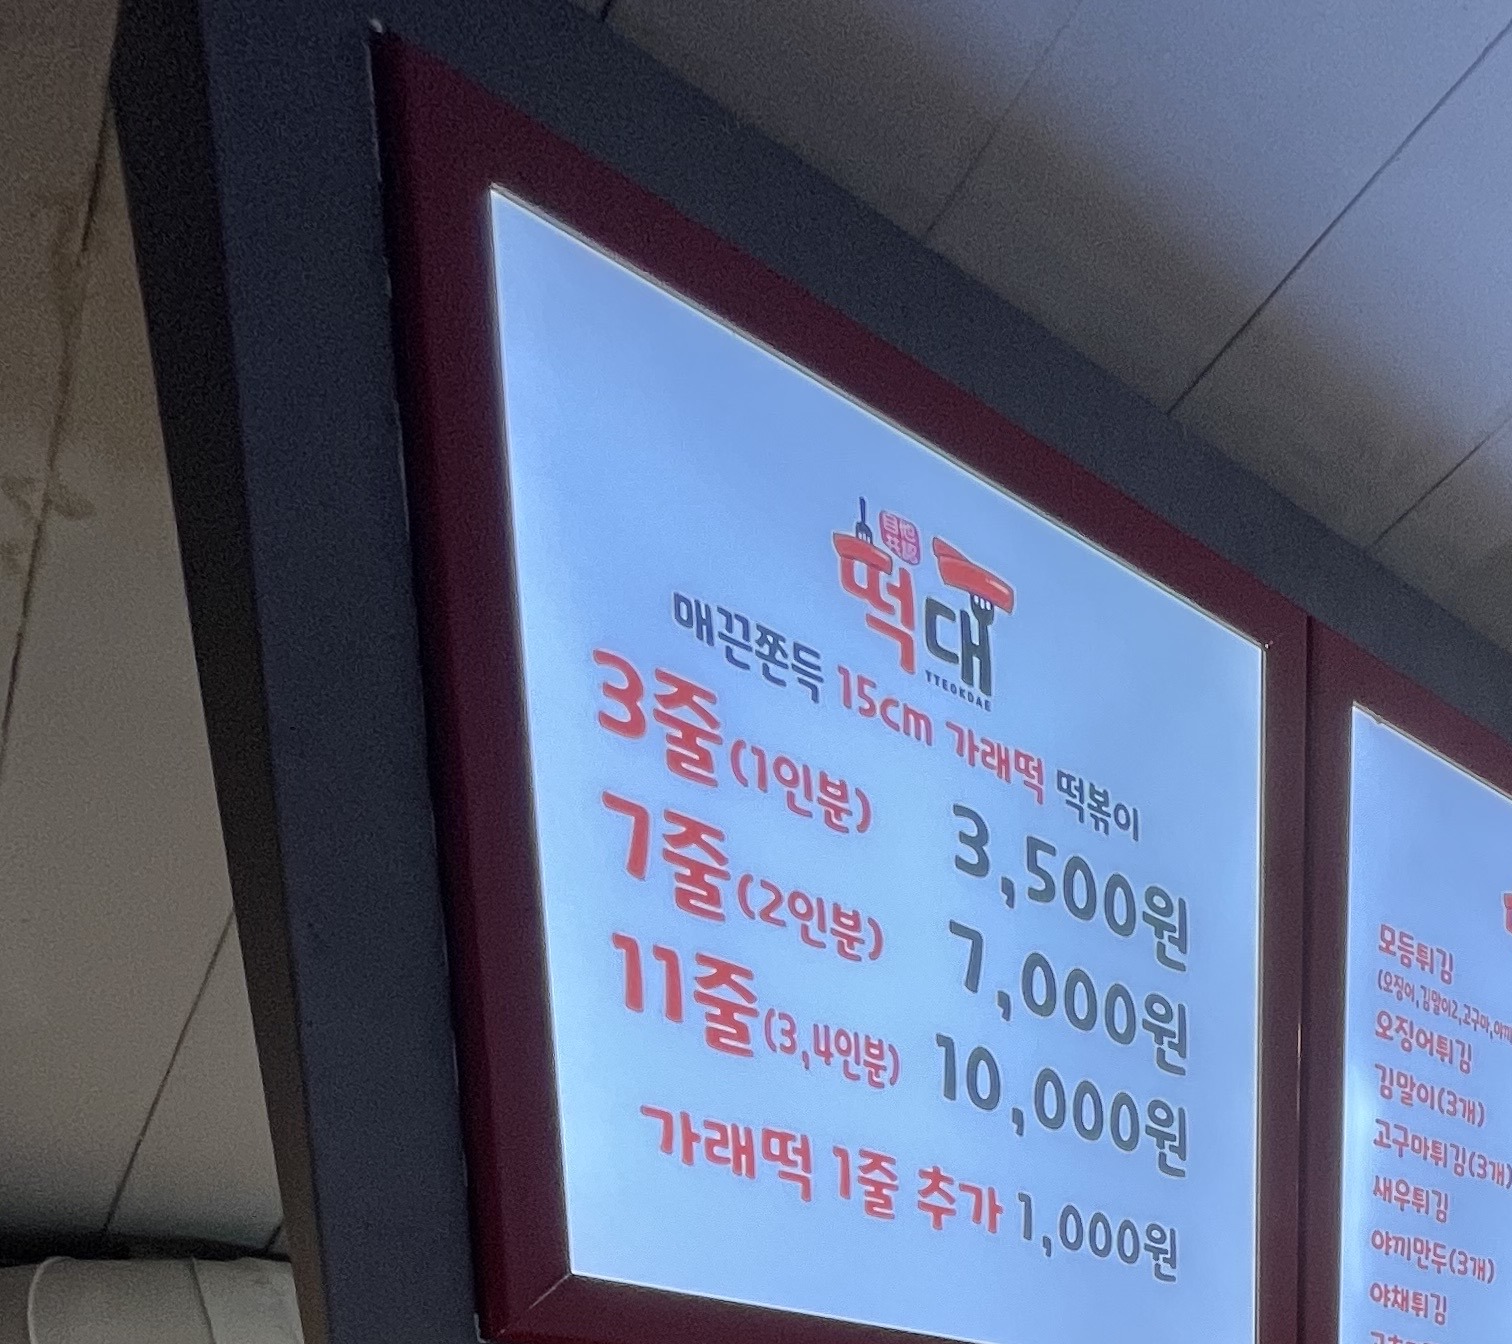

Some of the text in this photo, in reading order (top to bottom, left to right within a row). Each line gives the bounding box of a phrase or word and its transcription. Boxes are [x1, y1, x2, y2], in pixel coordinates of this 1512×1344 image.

[833, 530, 1016, 697] 떡대
[673, 592, 1140, 843] 매끈쫀득 15cm 가래떡 떡볶이
[952, 804, 1189, 972] 3,500원
[1378, 924, 1454, 985] 모듬튀김
[948, 920, 1188, 1076] 7,000원
[1375, 1010, 1472, 1074] 오징어튀김
[935, 1033, 1188, 1177] 10,000원
[1374, 1064, 1485, 1127] 김말이(3개)
[641, 1105, 1179, 1283] 가래떡 1줄 추가 1,000원
[1372, 1177, 1449, 1224] 새우튀김
[1369, 1282, 1448, 1326] 야채튀김
